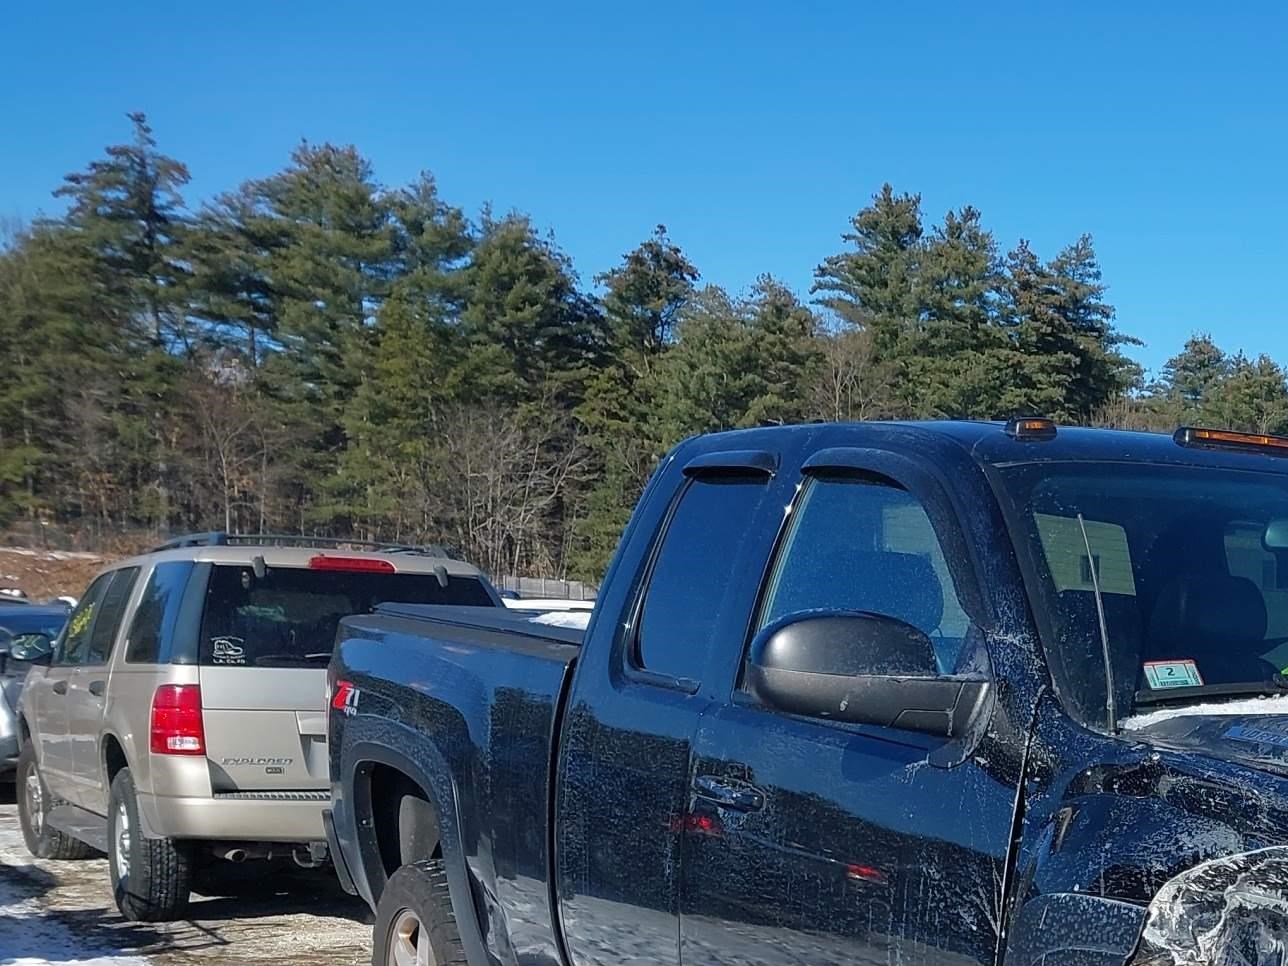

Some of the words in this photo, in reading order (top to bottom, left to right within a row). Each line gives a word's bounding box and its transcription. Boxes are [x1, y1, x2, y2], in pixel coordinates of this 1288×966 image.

[1166, 667, 1176, 676] 2
[332, 680, 361, 709] Z71
[221, 757, 294, 766] EXPLORER
